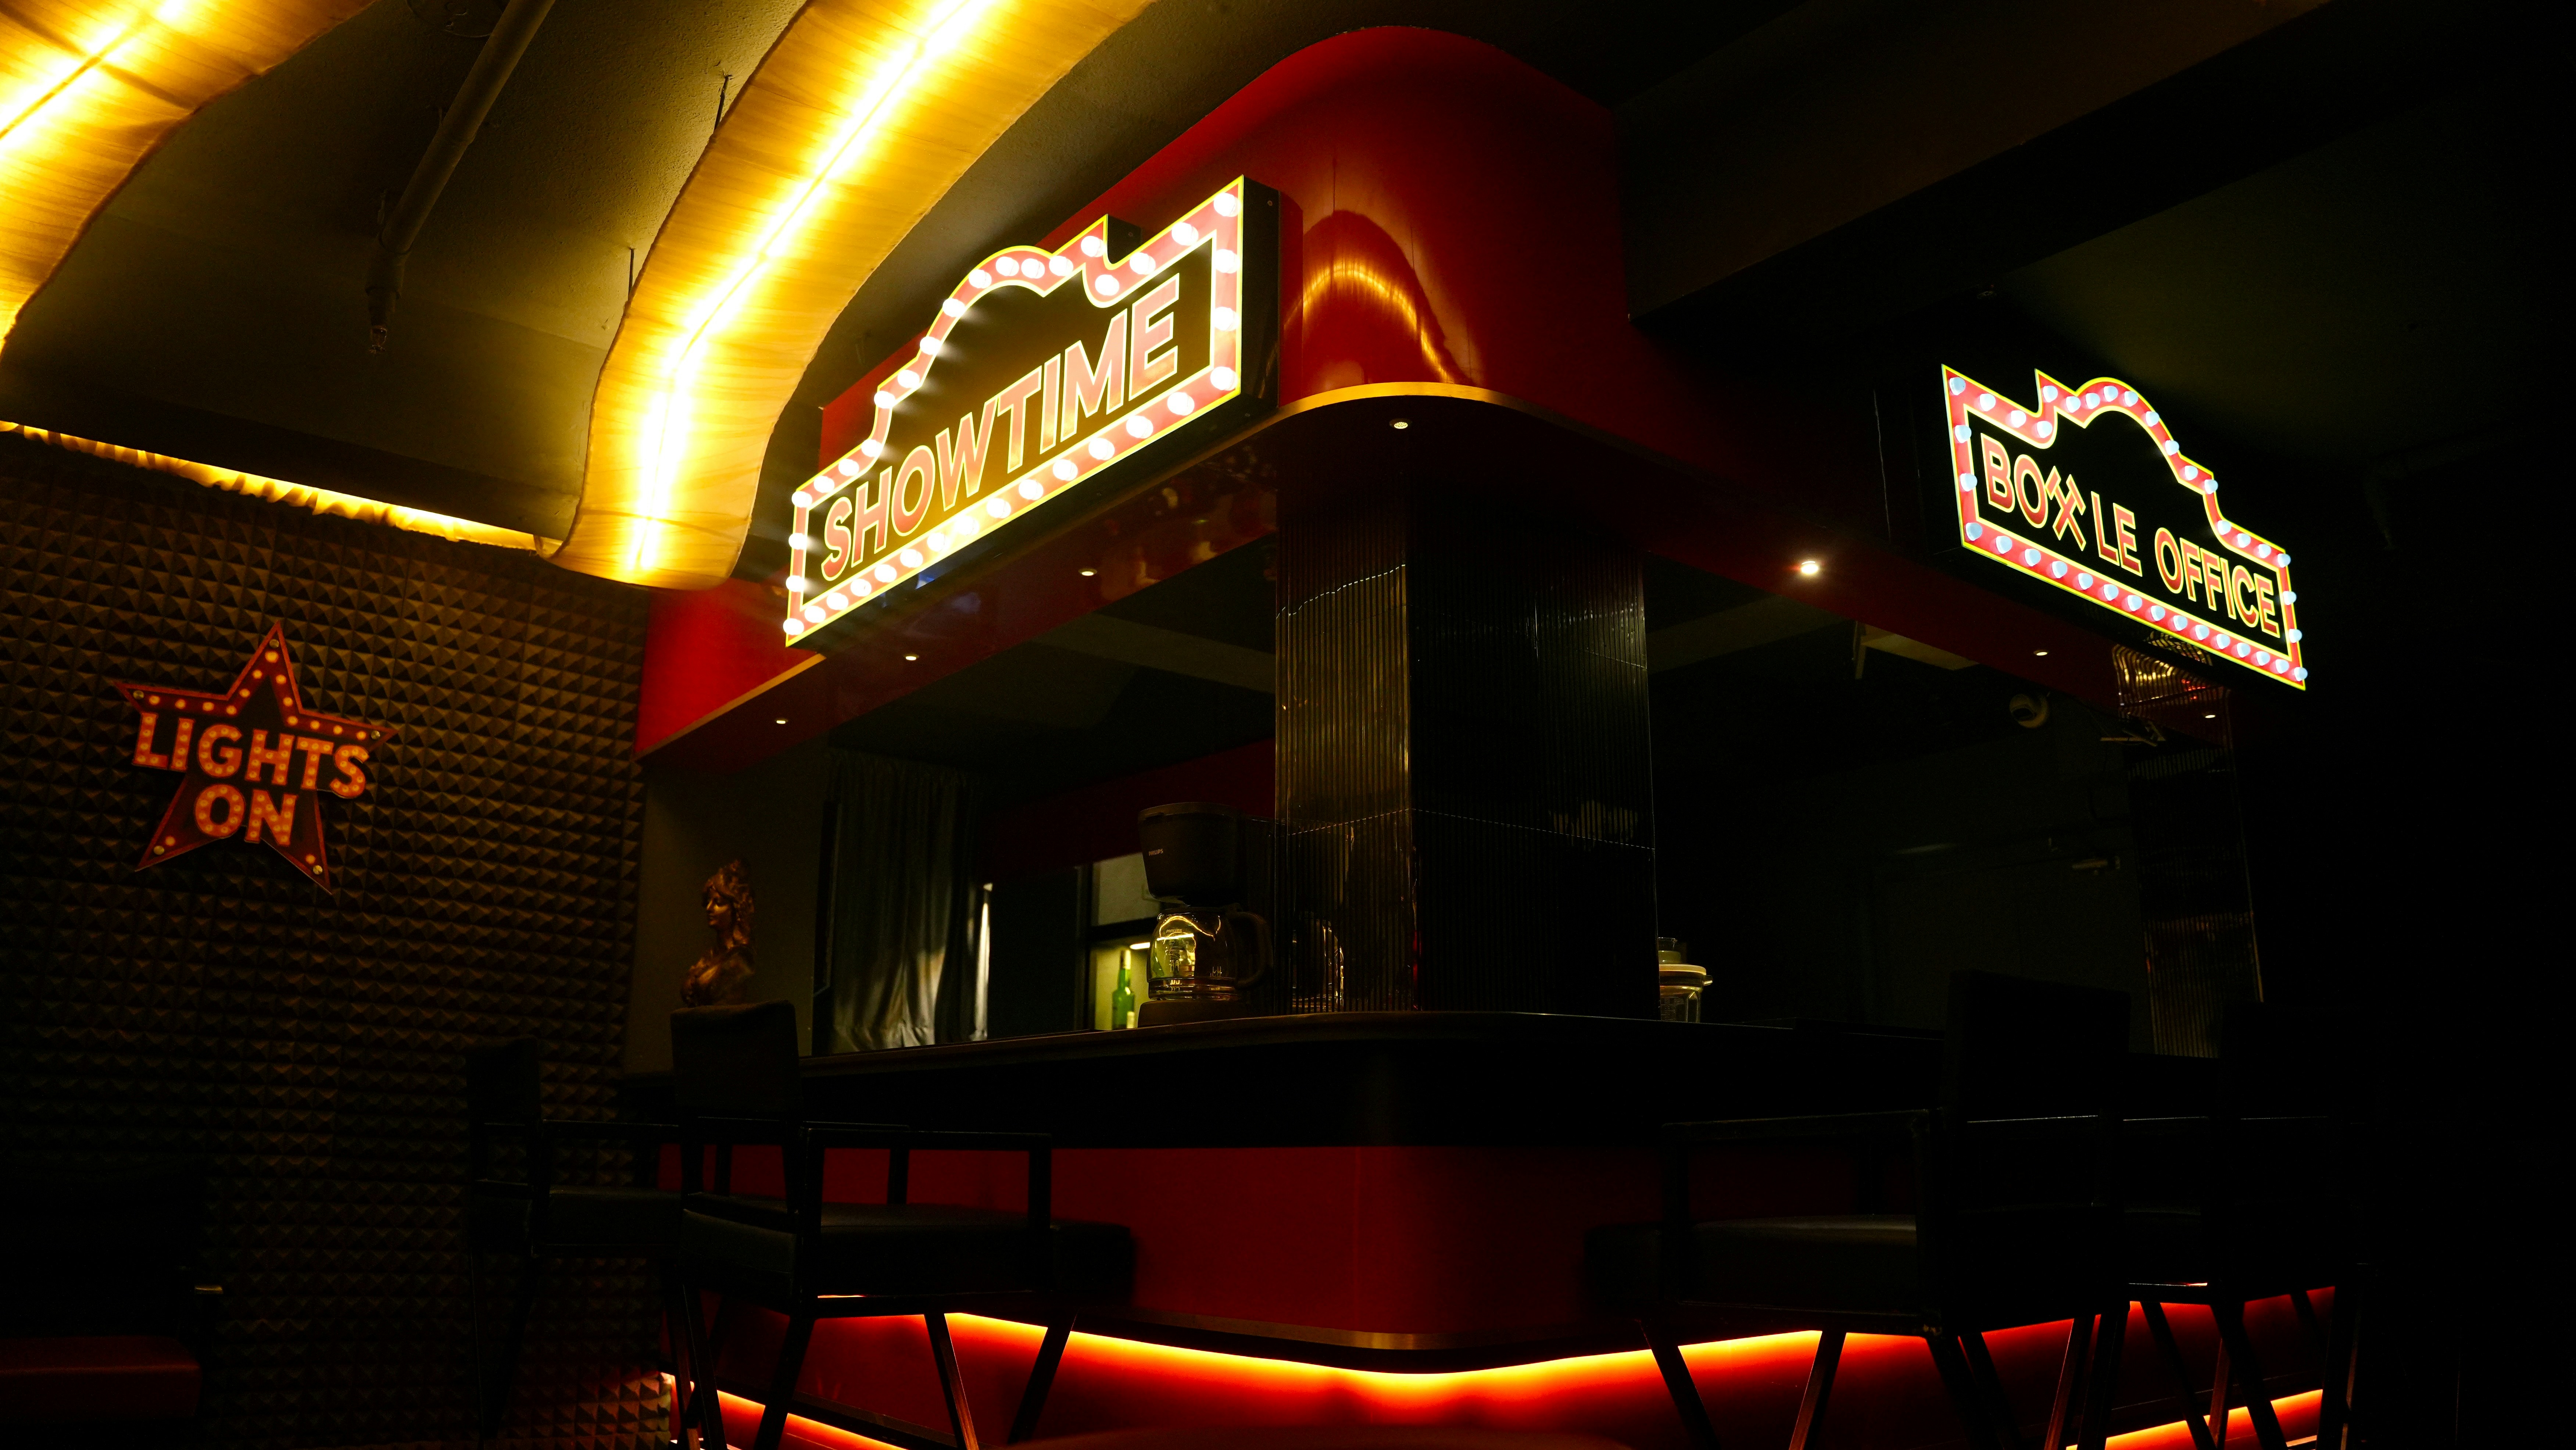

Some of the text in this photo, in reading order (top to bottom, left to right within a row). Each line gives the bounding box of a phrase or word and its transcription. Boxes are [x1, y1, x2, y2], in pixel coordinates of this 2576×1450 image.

[821, 273, 1180, 581] SHOWTIME
[2154, 528, 2280, 638] OFFICE
[132, 712, 370, 799] LIGHTS
[193, 783, 298, 847] ON
